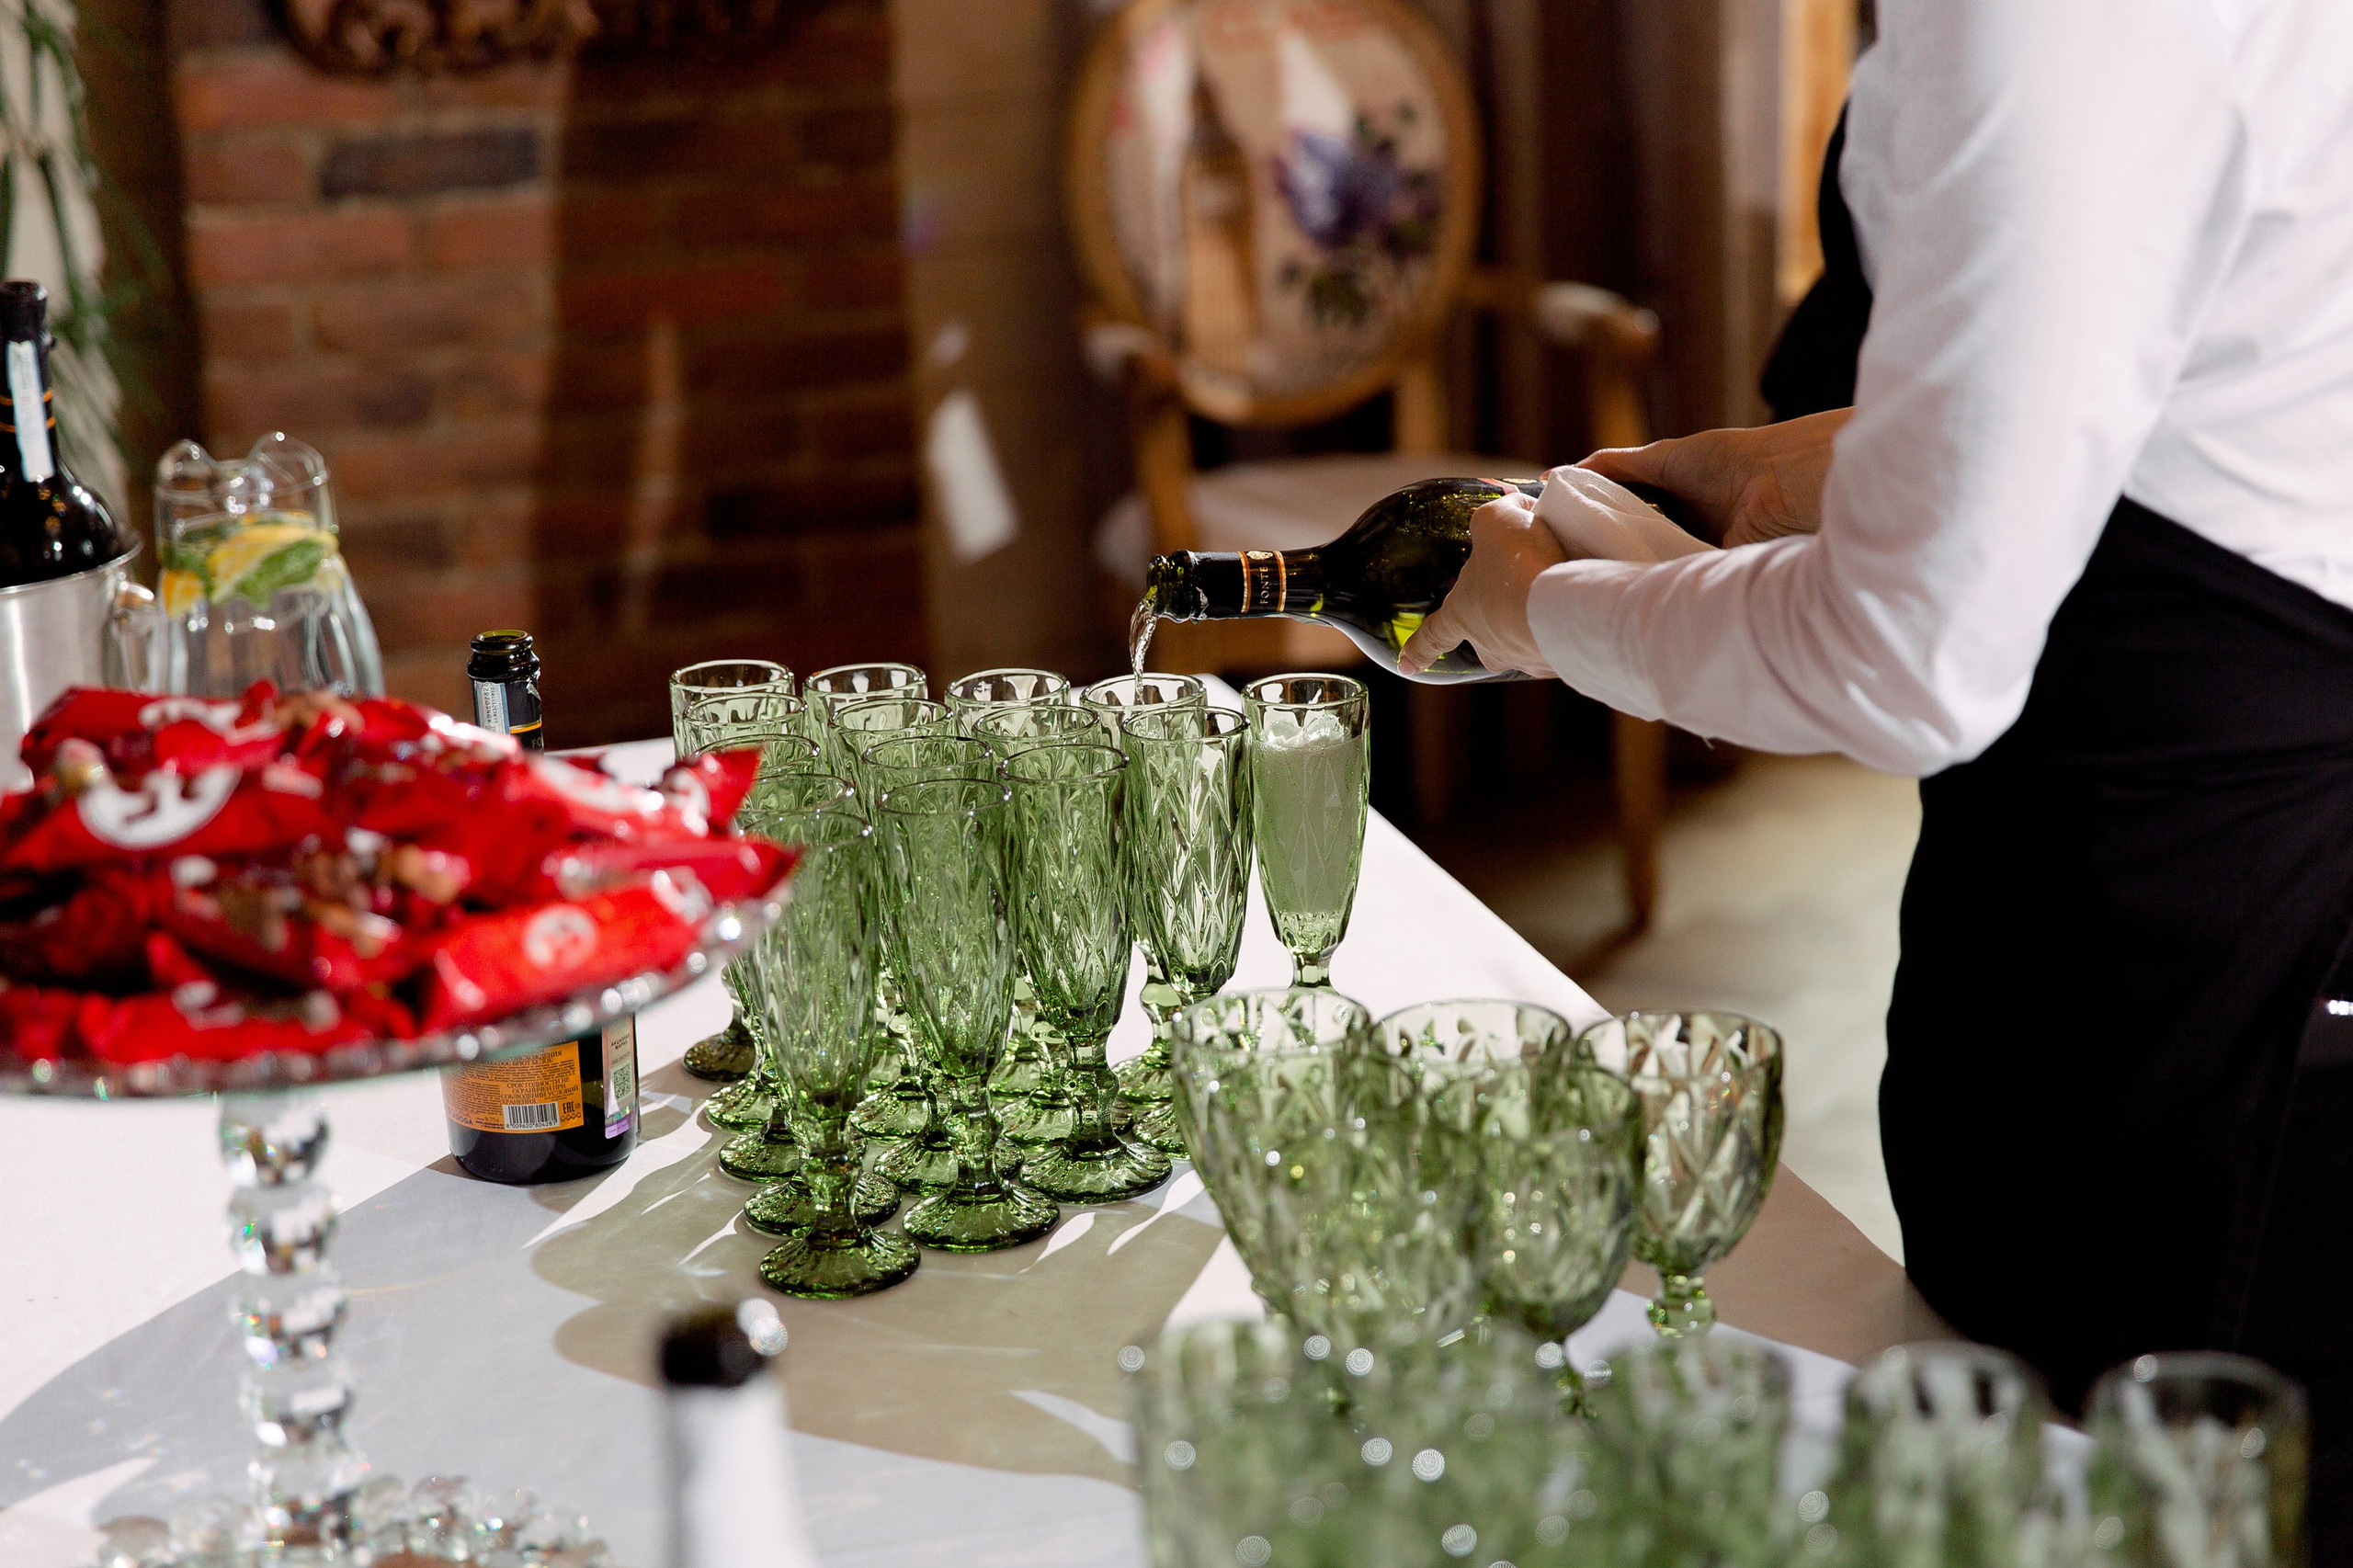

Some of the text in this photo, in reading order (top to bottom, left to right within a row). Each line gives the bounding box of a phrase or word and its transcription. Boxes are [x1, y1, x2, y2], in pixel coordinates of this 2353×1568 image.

[1260, 566, 1269, 604] FONTE
[525, 1079, 560, 1088] ГОДНОСТИ
[501, 1091, 547, 1099] СОБЛЮДЕНИИ
[547, 1085, 579, 1096] УСЛОВИЙ
[512, 1085, 551, 1094] ОГРАНИЧЕН
